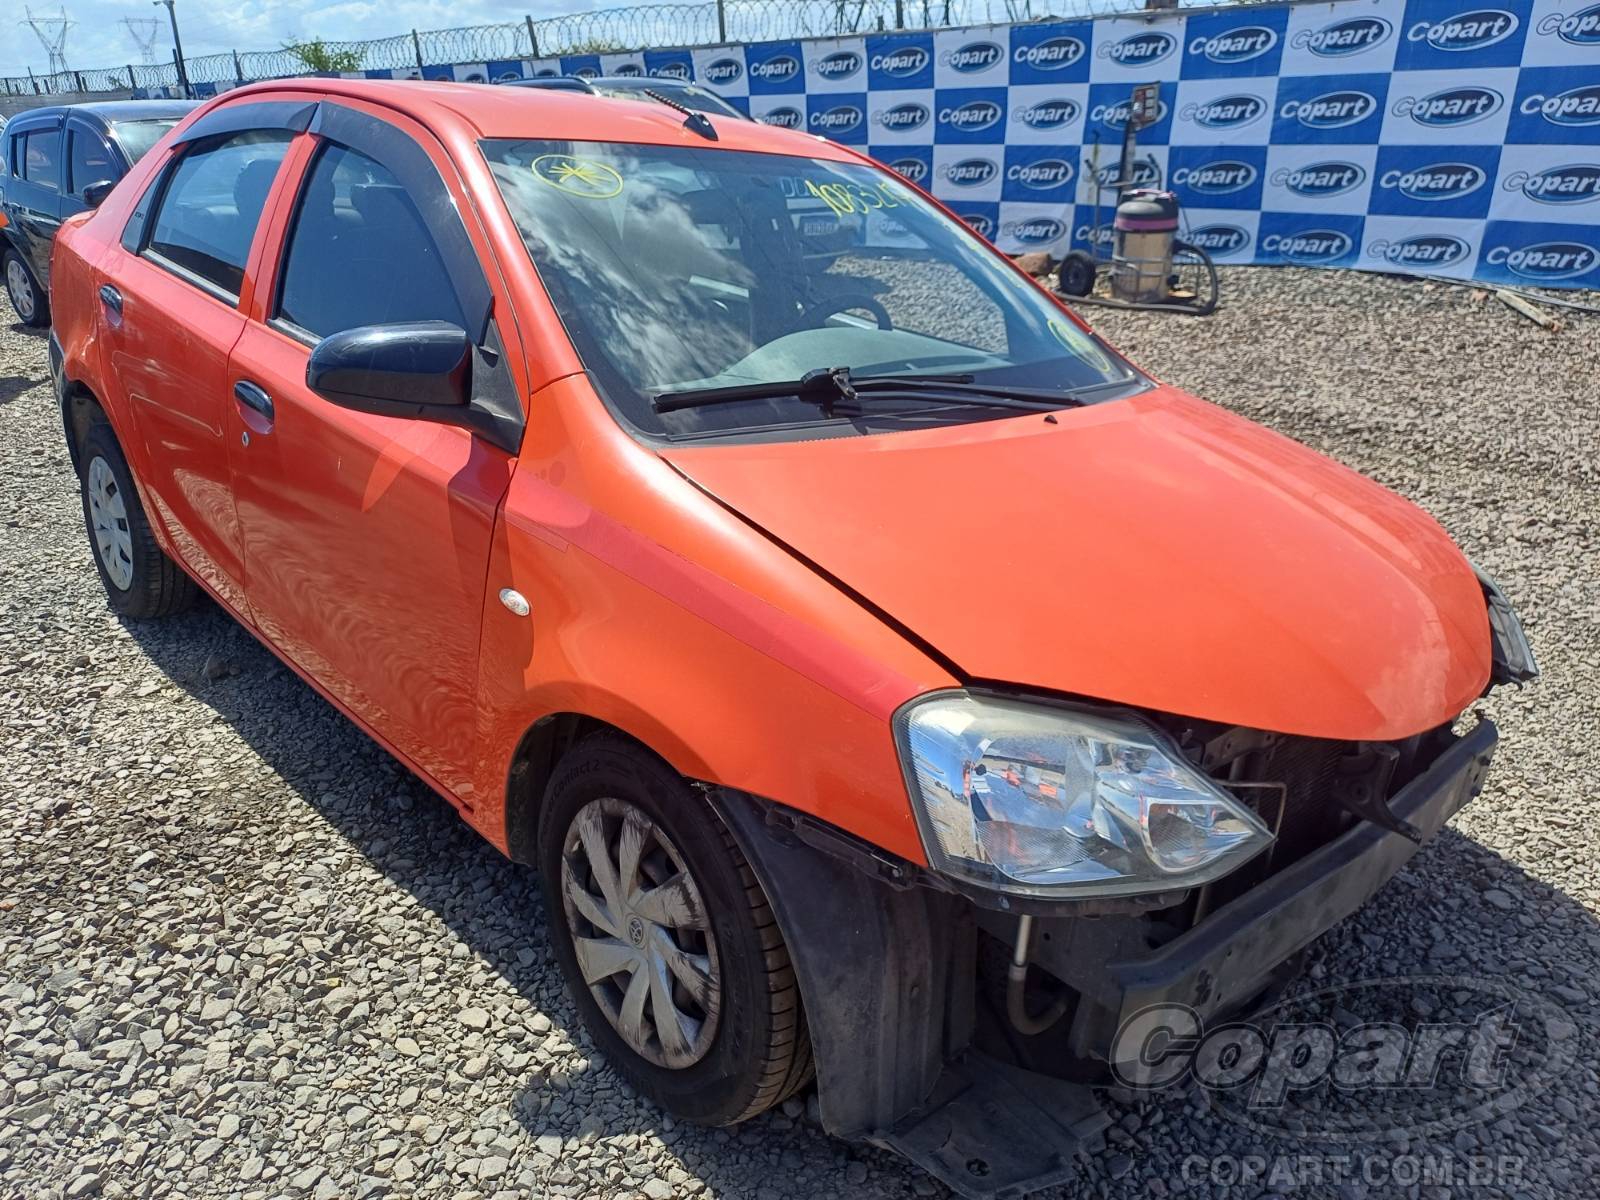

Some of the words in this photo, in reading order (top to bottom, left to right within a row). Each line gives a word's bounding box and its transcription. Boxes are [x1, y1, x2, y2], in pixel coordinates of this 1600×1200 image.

[1290, 22, 1386, 54] Copart
[1407, 16, 1507, 50] Copart
[939, 47, 995, 71] Copart
[1014, 41, 1077, 68] Copart
[1097, 35, 1169, 66] Copart
[1188, 32, 1267, 62] Copart
[750, 60, 794, 80] Copart
[871, 50, 922, 74] Copart
[810, 110, 857, 131] Copart
[871, 107, 924, 130] Copart
[939, 106, 995, 129] Copart
[1013, 103, 1074, 128] Copart
[1179, 98, 1259, 128] Copart
[1280, 97, 1368, 127] Copart
[1391, 91, 1490, 125] Copart
[936, 164, 991, 183] Copart
[1007, 162, 1068, 186] Copart
[1172, 165, 1247, 192] Copart
[1269, 166, 1356, 195] Copart
[1379, 168, 1474, 198] Copart
[1002, 219, 1056, 239] Copart
[1262, 234, 1348, 261] Copart
[1367, 238, 1463, 266] Copart
[1486, 244, 1590, 275] Copart
